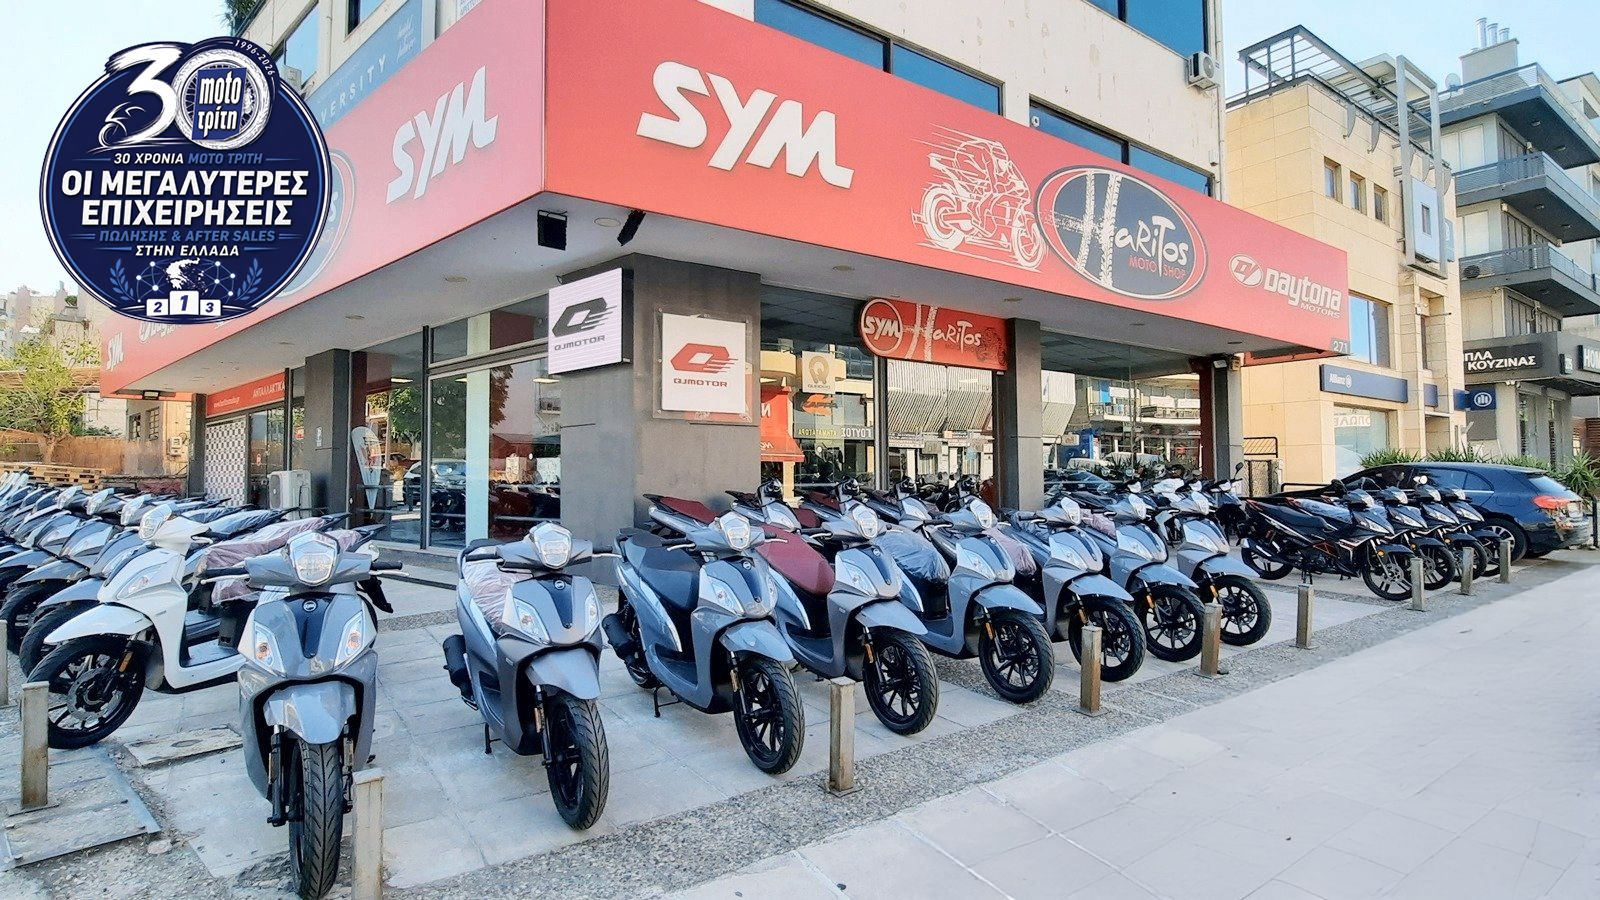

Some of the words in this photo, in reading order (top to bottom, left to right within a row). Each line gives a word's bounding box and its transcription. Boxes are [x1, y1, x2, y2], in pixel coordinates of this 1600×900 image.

[319, 53, 387, 124] VERSITY
[386, 64, 499, 205] SYM
[636, 61, 855, 189] SYM
[1129, 255, 1157, 273] MOTO
[1163, 264, 1187, 280] SHOP
[1264, 268, 1342, 307] Daytona
[1300, 303, 1341, 319] MOTORS
[863, 316, 901, 340] SYM
[106, 332, 125, 372] SYM
[554, 335, 606, 351] QJMOTOR
[1333, 341, 1348, 354] 271
[1465, 350, 1493, 362] ΠΛΑ
[1468, 355, 1537, 371] ΚΟΥΖΙΝΑΣ
[673, 377, 728, 388] QJMOTOR
[1329, 373, 1346, 386] Allianz
